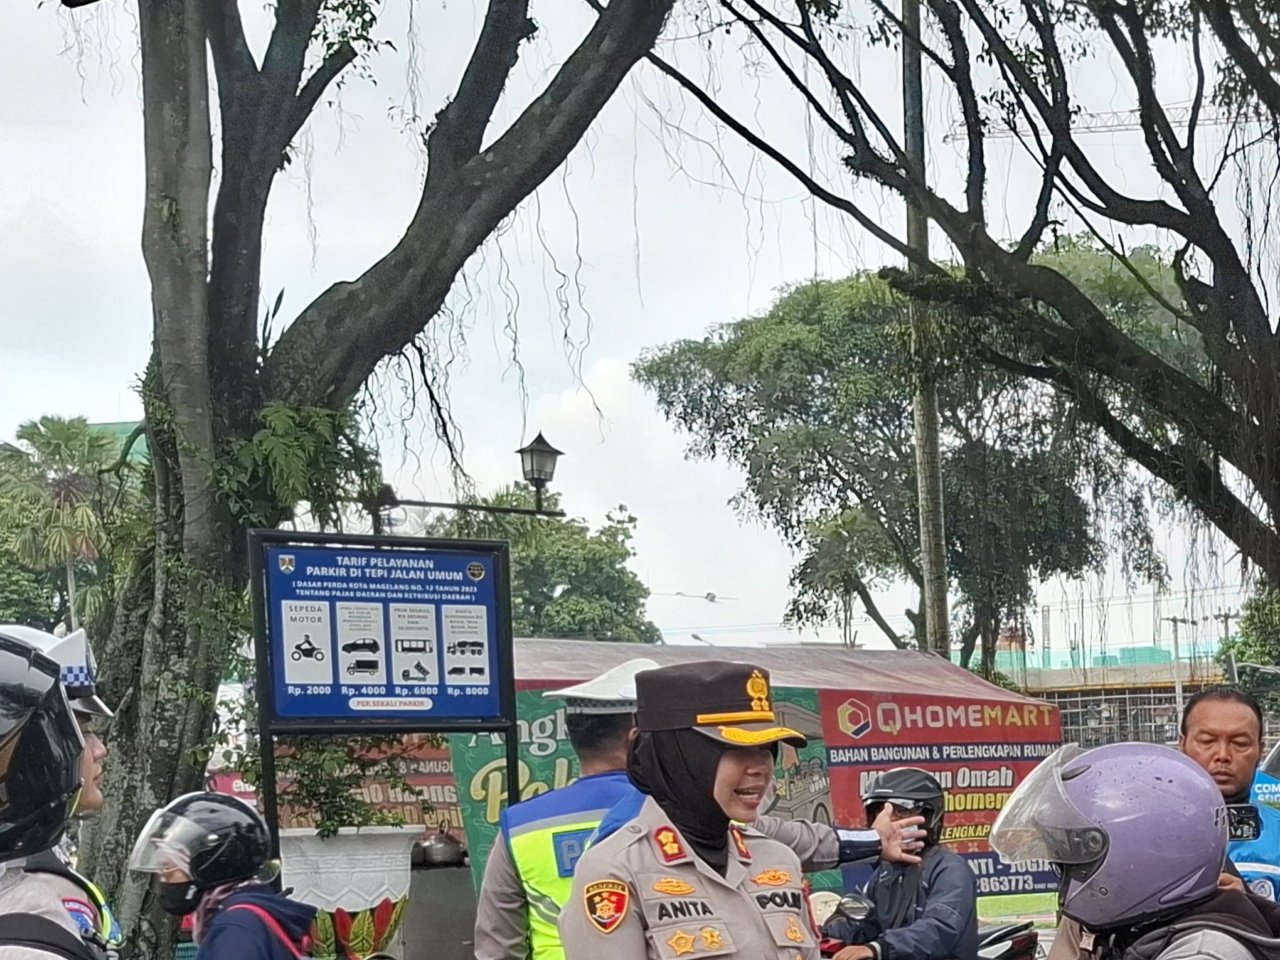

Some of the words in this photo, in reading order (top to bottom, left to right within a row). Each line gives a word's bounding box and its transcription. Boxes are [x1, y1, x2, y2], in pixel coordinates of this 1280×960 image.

[336, 556, 368, 567] TARIF
[370, 557, 434, 569] PELAYANAN
[306, 566, 347, 577] PARKIR
[350, 567, 361, 578] DI
[364, 568, 388, 578] TEPI
[390, 569, 425, 580] JALAN
[427, 570, 463, 581] UMUM
[297, 580, 322, 588] DASAR
[323, 581, 348, 589] PERDA
[349, 582, 368, 590] KOTA
[369, 583, 409, 591] MAGELANG
[425, 584, 434, 592] 12
[435, 585, 460, 593] TAHUN
[296, 589, 330, 597] TENTANG
[356, 590, 386, 598] DAERAH
[387, 591, 403, 599] DAN
[404, 592, 441, 600] RETRIBUSI
[288, 605, 323, 613] SEPEDA
[289, 616, 323, 624] MOTOR
[288, 686, 304, 696] Rp.
[307, 686, 331, 695] 2000
[341, 687, 359, 697] Rp.
[361, 687, 386, 695] 4000
[395, 687, 412, 697] Rp.
[414, 687, 438, 695] 6000
[447, 687, 464, 697] Rp.
[372, 700, 397, 708] SEKALI
[876, 702, 1053, 736] QHOMEMART
[830, 747, 869, 763] BAHAN
[870, 746, 930, 762] BANGUNAN
[932, 746, 940, 759] &
[942, 744, 1022, 760] PERLENGKAPAN
[956, 766, 1014, 789] Omah
[657, 901, 714, 921] ANITA
